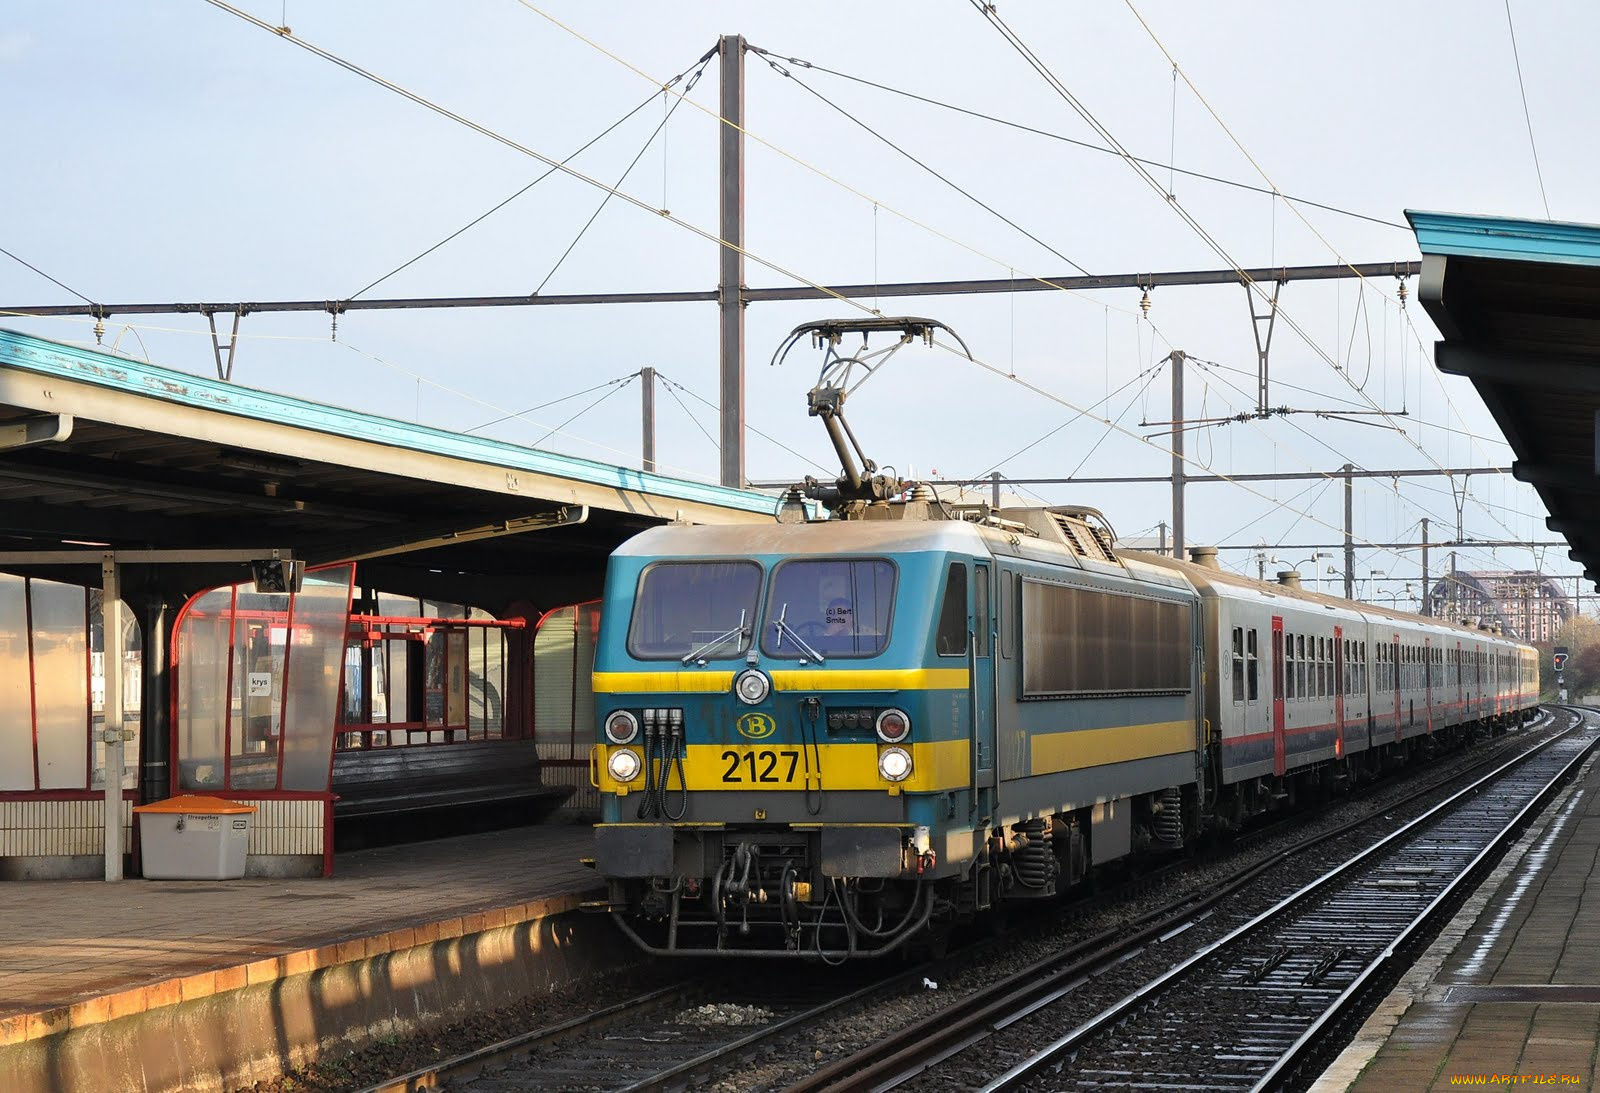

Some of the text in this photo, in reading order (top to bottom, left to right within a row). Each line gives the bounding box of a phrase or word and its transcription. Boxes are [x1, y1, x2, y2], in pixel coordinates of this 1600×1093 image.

[251, 678, 268, 687] krys
[747, 716, 767, 735] B
[721, 750, 799, 783] 2127
